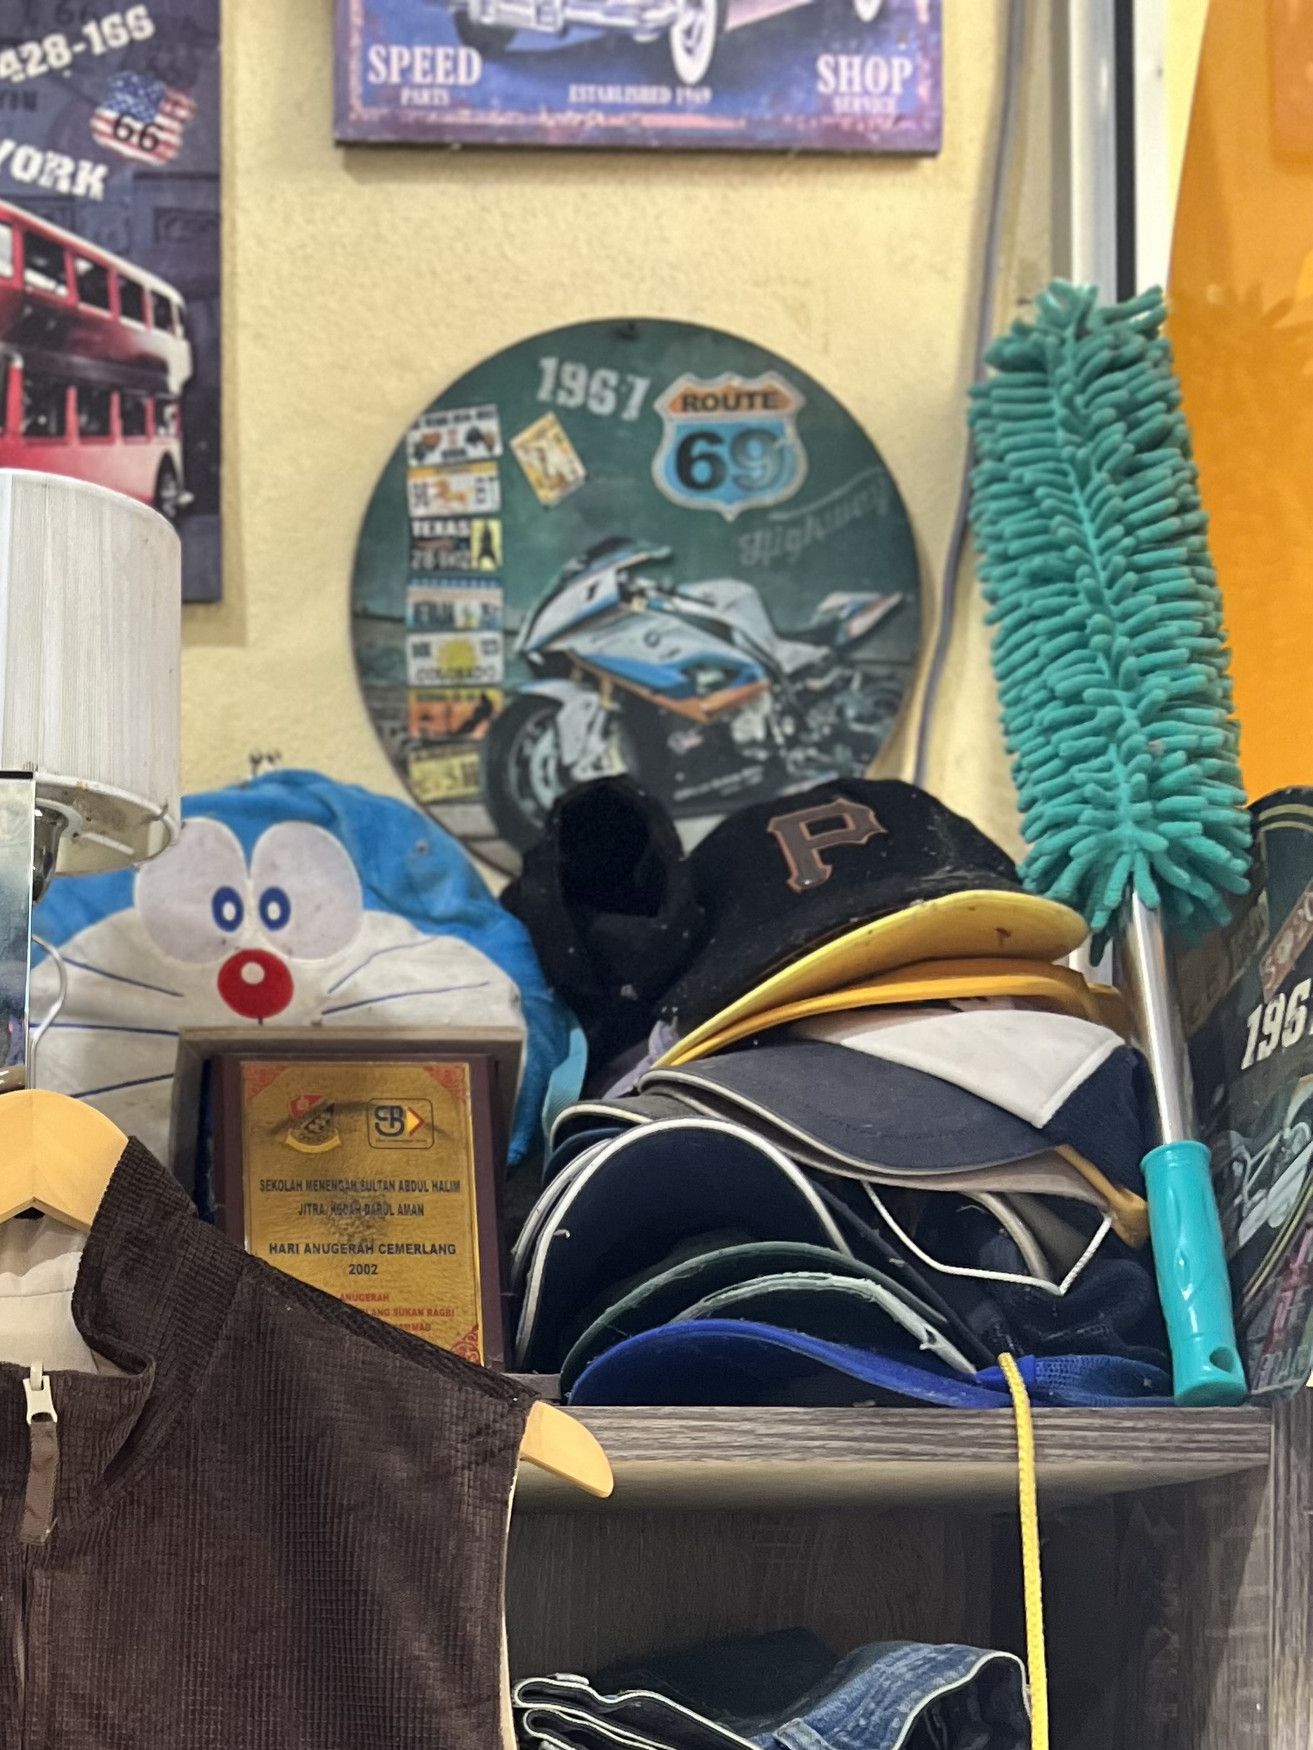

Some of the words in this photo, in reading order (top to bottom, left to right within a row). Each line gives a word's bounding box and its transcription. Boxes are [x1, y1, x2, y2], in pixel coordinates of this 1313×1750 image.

[367, 45, 483, 86] SPEED
[816, 54, 913, 95] SHOP
[112, 112, 164, 151] 66
[536, 357, 652, 421] 1967
[681, 391, 780, 413] ROUTE
[676, 428, 784, 493] 69
[412, 519, 471, 538] TEXAS
[767, 798, 888, 893] P
[1241, 977, 1313, 1071] 196
[260, 1180, 303, 1192] SEKOLAH
[305, 1180, 357, 1192] MENENGAH
[359, 1180, 396, 1192] SULTAN
[398, 1180, 429, 1192] ABDUL
[432, 1180, 461, 1193] HALIM
[397, 1203, 424, 1216] AMAN
[269, 1243, 299, 1255] HARI
[304, 1243, 374, 1255] ANUGERAH
[378, 1243, 456, 1255] CEMERLANG
[348, 1264, 379, 1275] 2002
[339, 1293, 390, 1302] ANUGERAH
[392, 1308, 424, 1317] SUKAN
[426, 1308, 455, 1317] RAGBI
